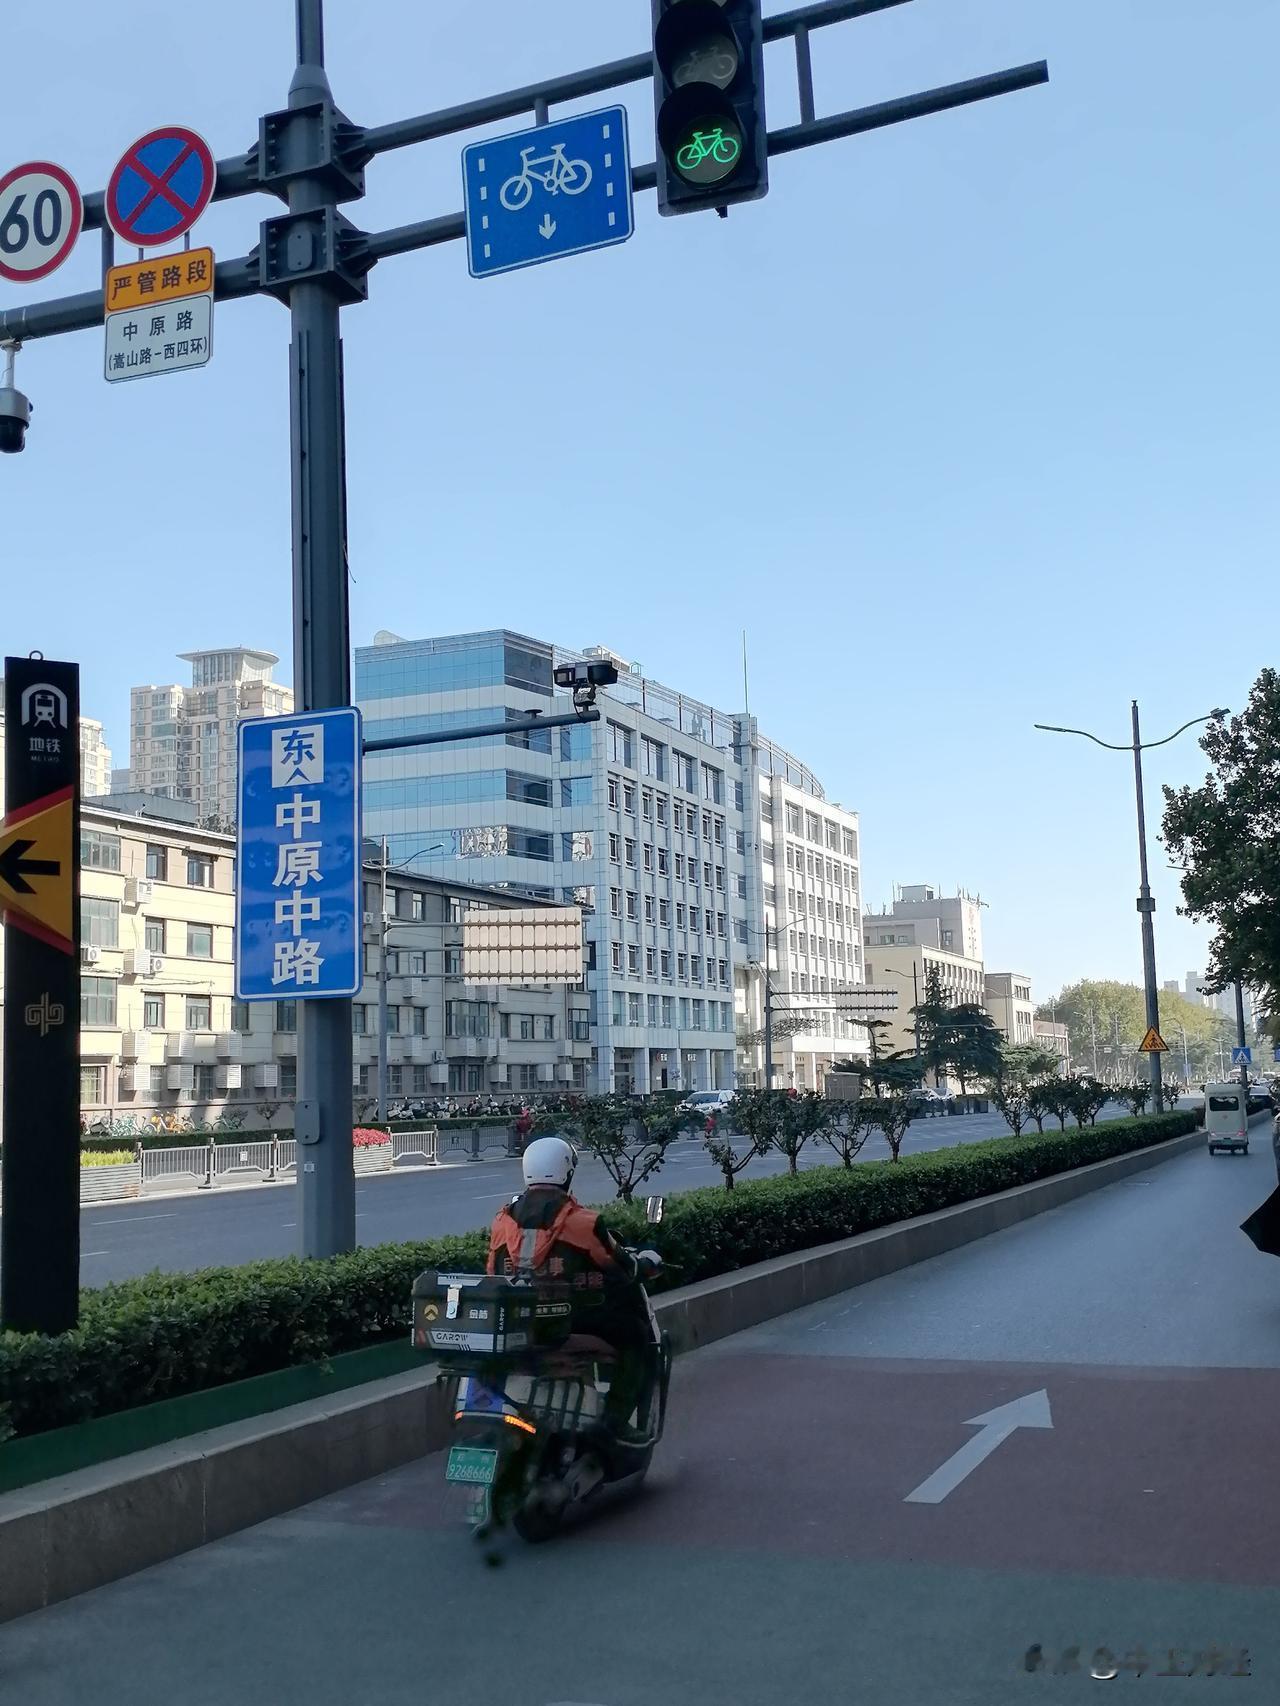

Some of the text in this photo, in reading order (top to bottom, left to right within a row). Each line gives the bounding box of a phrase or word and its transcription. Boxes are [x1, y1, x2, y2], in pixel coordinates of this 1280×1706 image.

[1, 188, 62, 254] 60
[112, 259, 208, 301] 严管路段
[123, 310, 194, 342] 中原路
[29, 736, 61, 754] 地铁
[280, 729, 316, 766] 东
[271, 792, 325, 986] 中原中路
